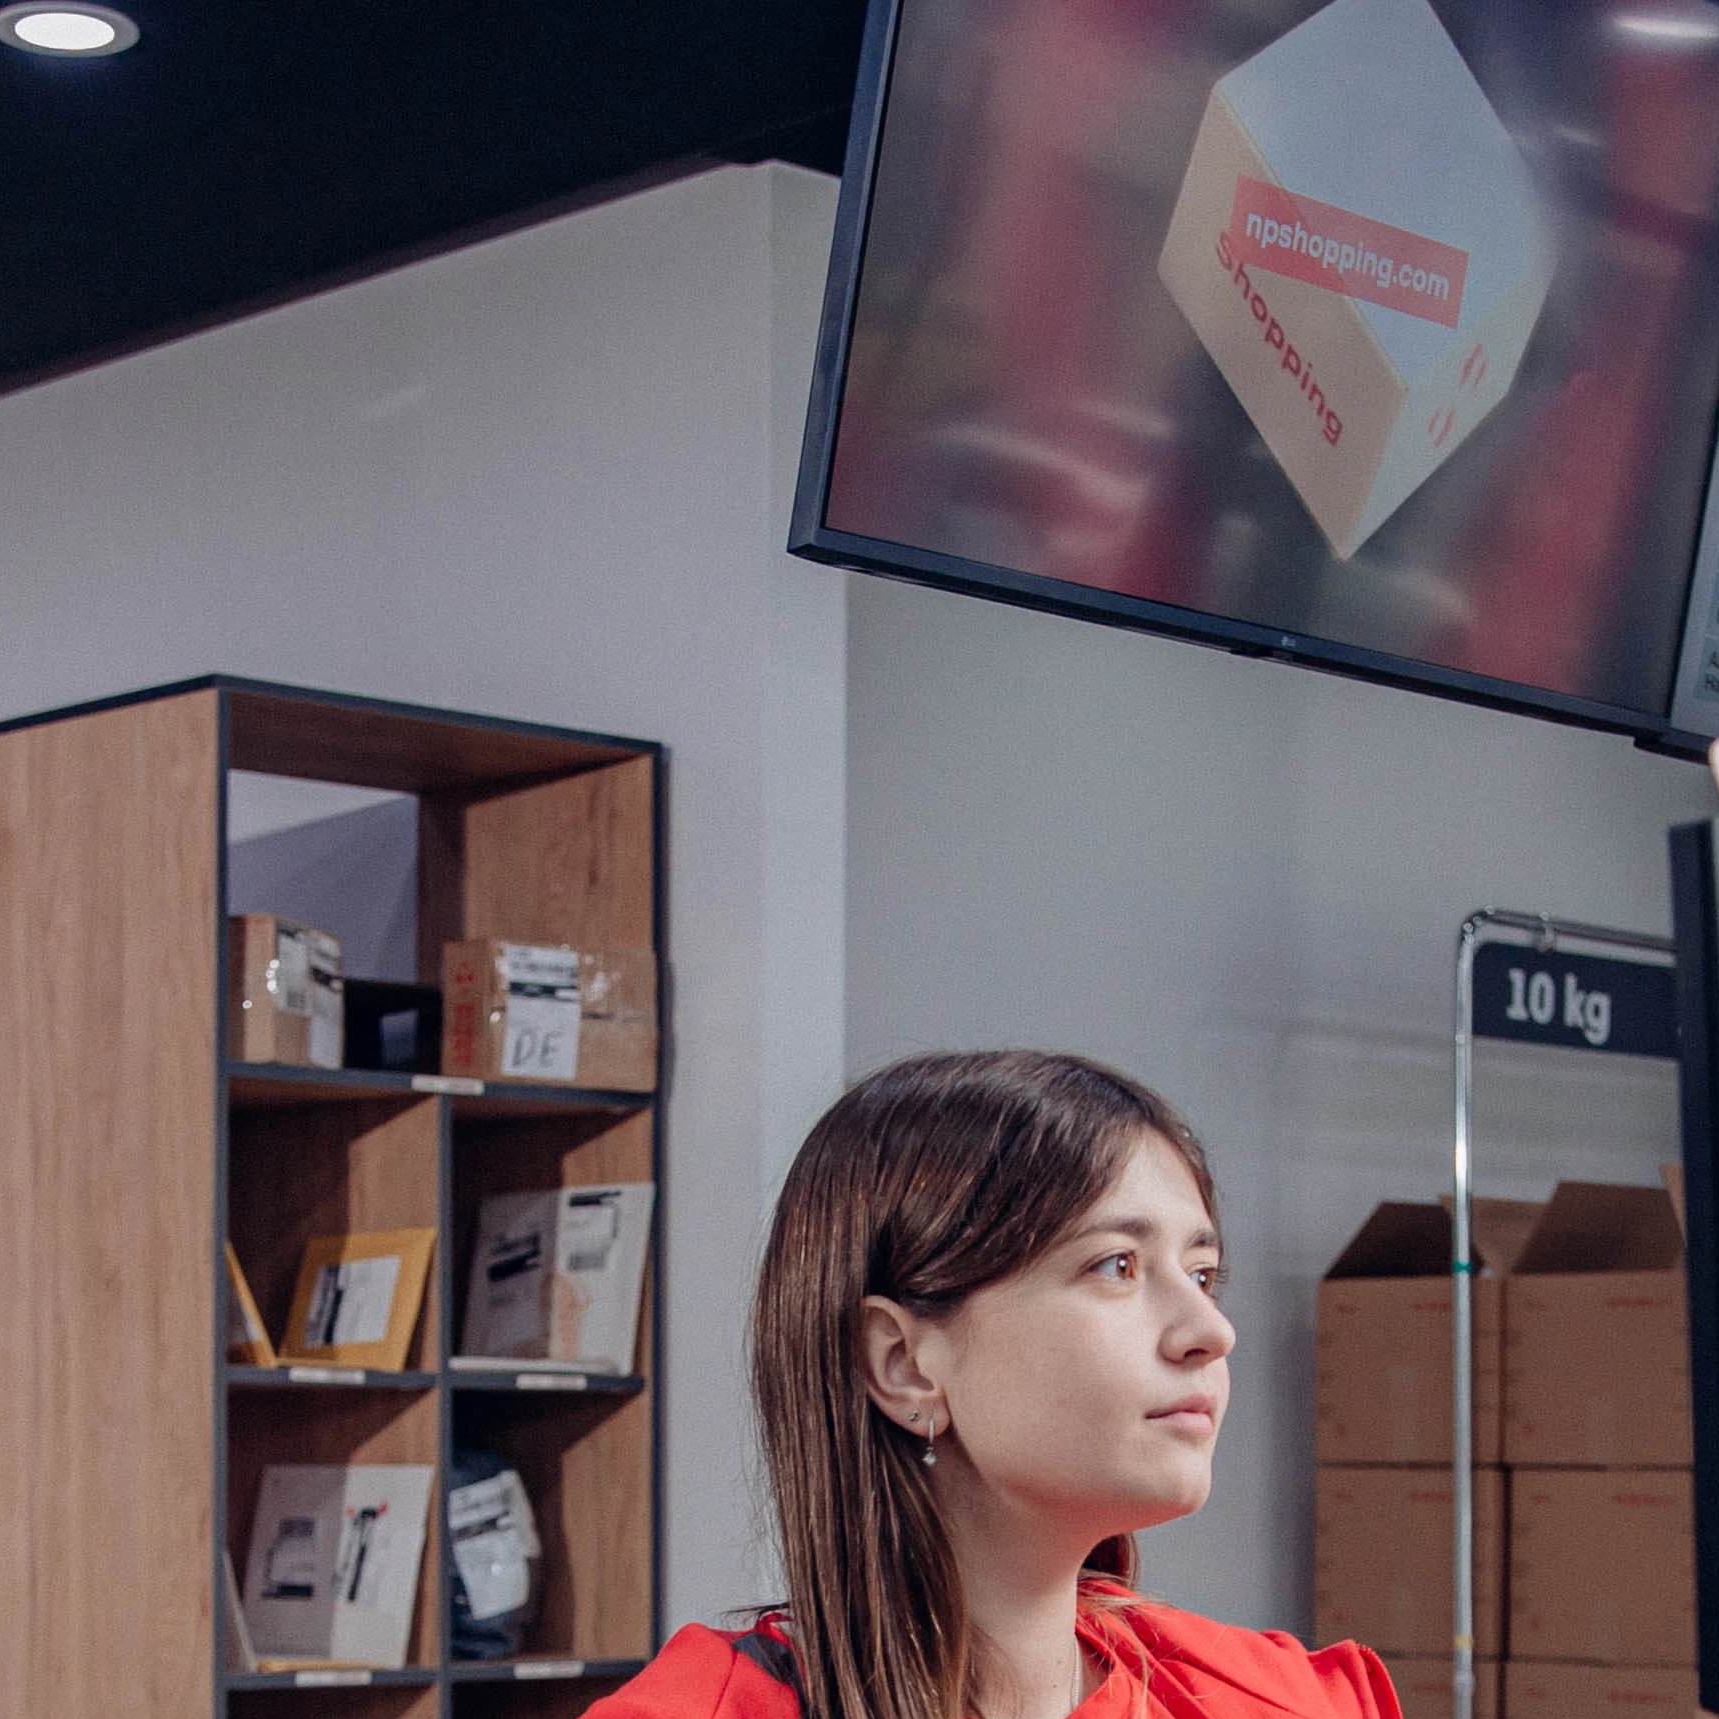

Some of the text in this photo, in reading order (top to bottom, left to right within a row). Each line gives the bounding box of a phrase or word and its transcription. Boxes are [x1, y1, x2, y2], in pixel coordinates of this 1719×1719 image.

[1245, 211, 1450, 300] npshopping.com
[1216, 231, 1343, 446] Shopping
[512, 1027, 563, 1069] DE
[1505, 966, 1612, 1046] 10 kg
